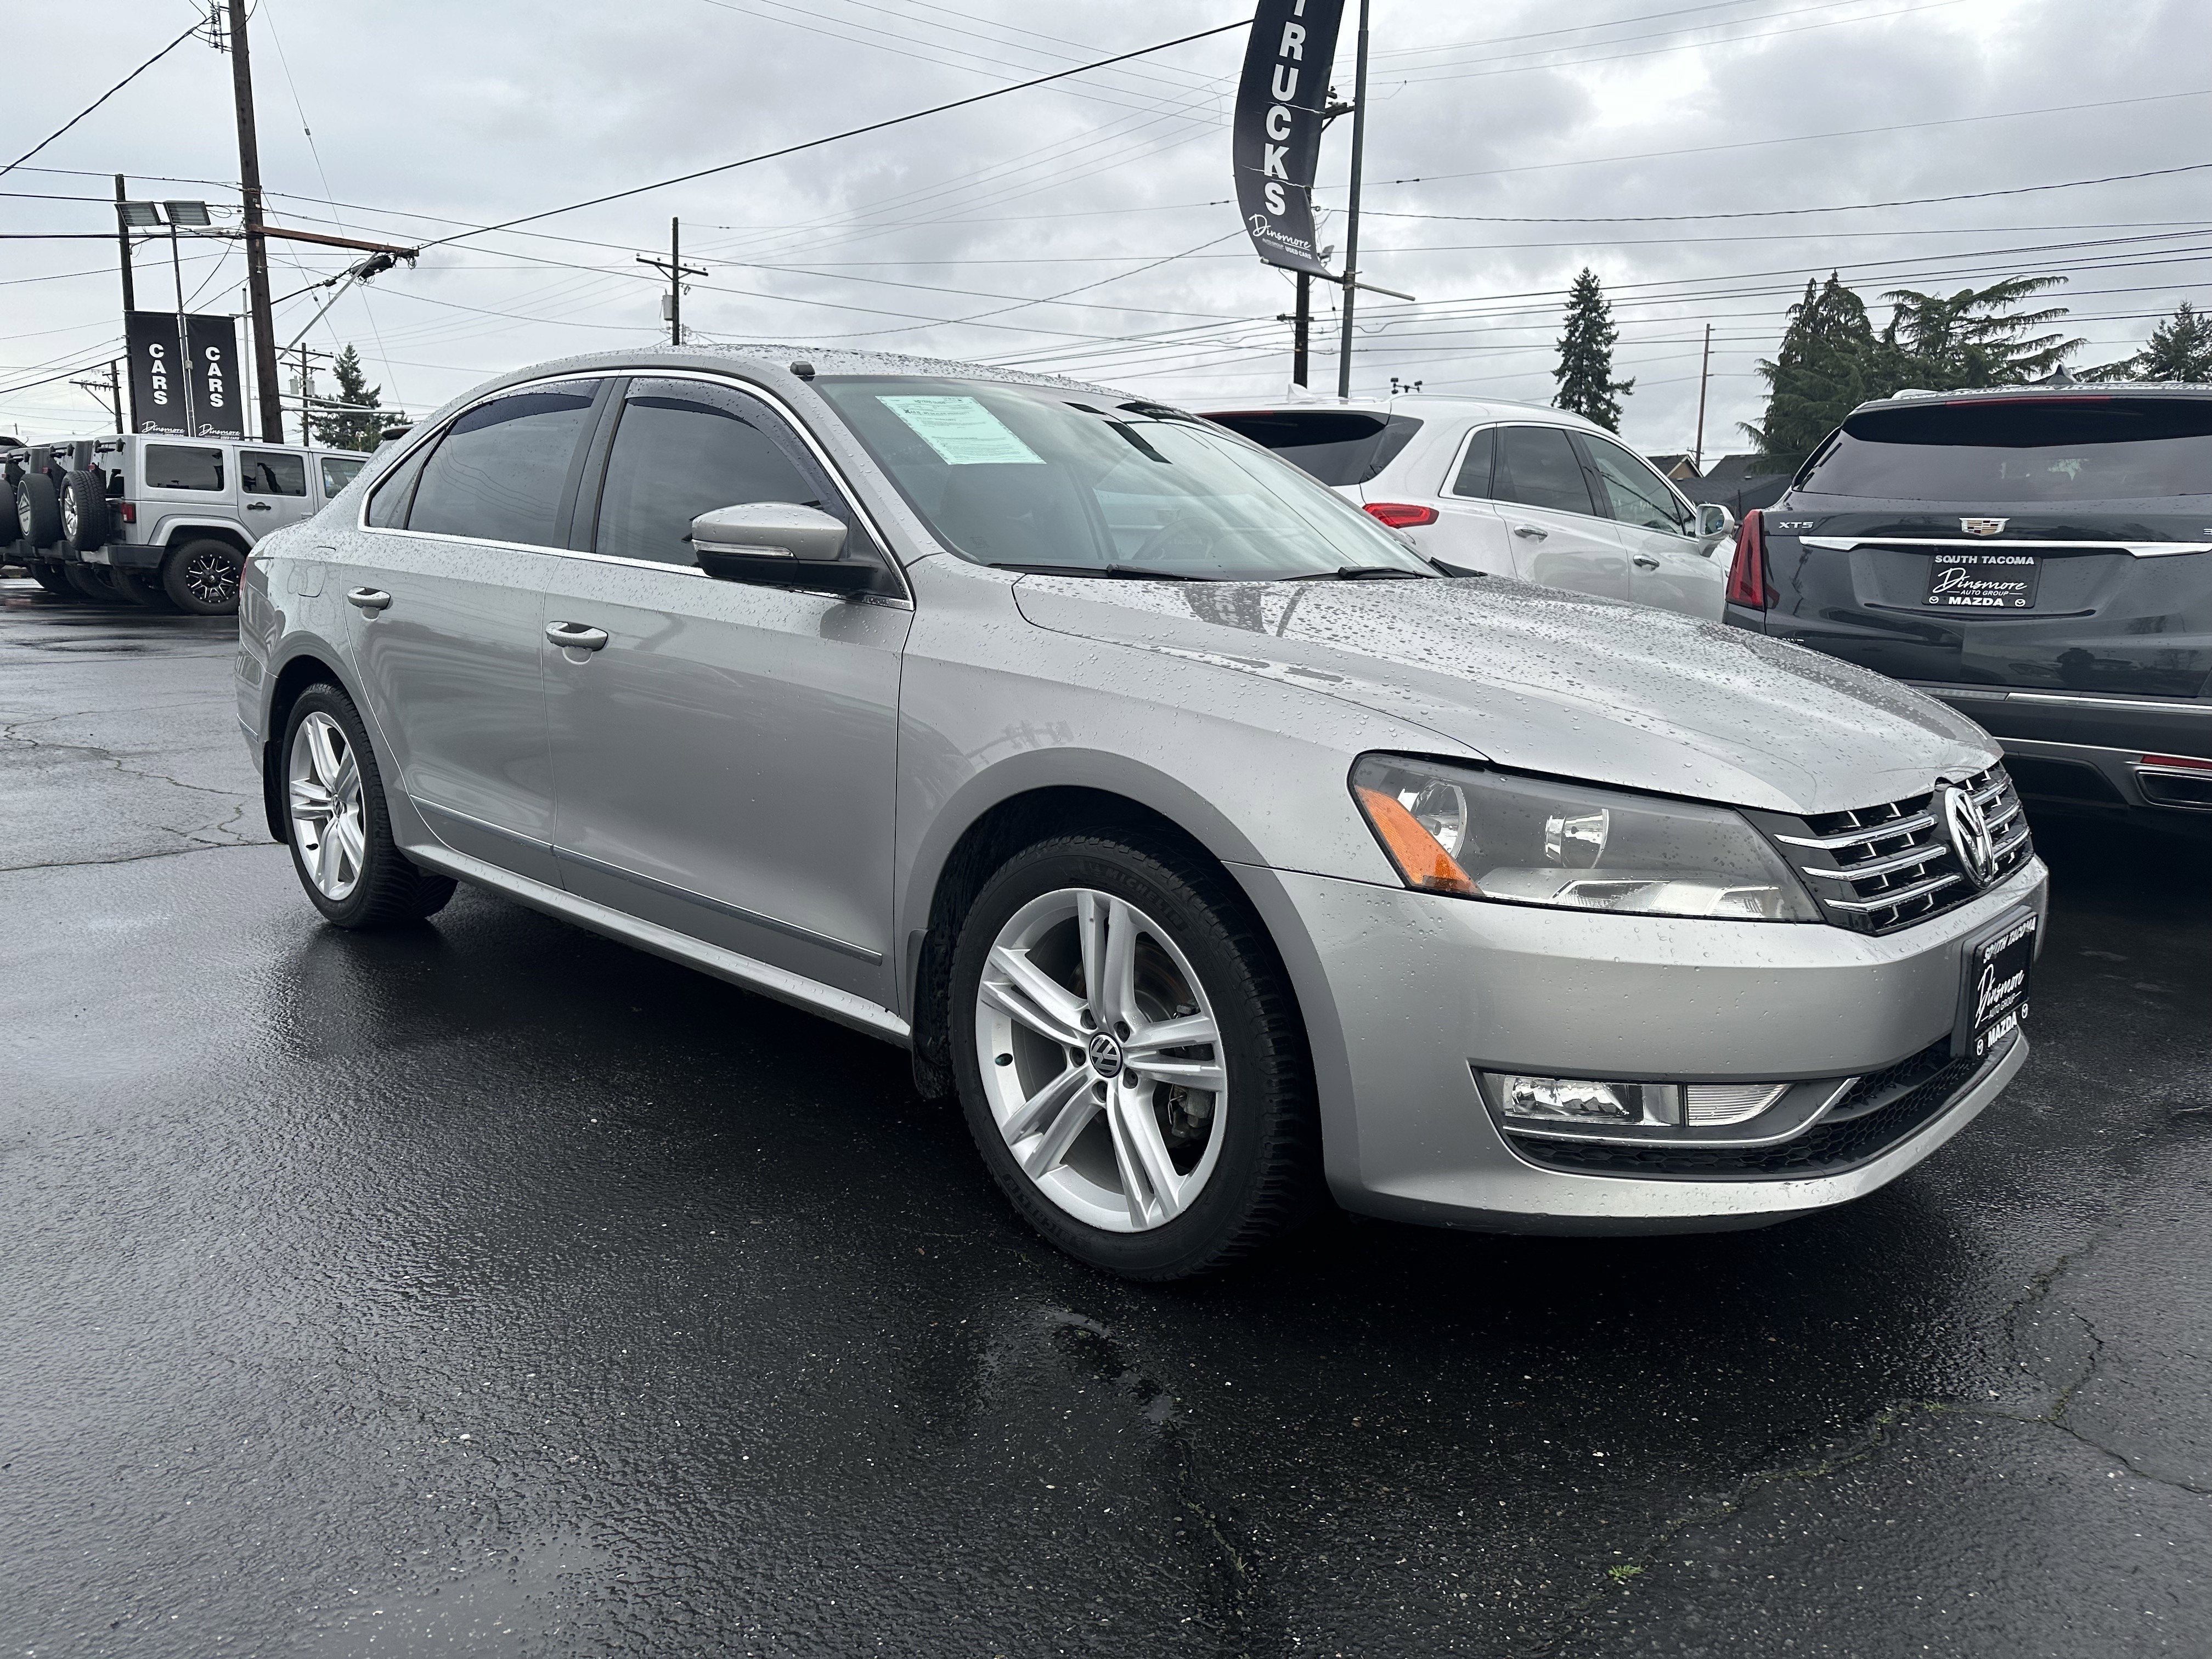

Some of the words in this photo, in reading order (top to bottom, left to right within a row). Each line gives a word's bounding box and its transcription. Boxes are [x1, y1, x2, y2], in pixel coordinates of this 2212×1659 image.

[1249, 214, 1311, 248] Dinsmore
[1299, 251, 1312, 259] CARS
[149, 344, 167, 405] CARS
[205, 347, 224, 407] CARS
[142, 421, 185, 433] Dinsmore
[199, 424, 240, 436] Dinsmore
[1935, 555, 1978, 564] SOUTH
[1982, 556, 2035, 565] TACOMA
[1932, 567, 2028, 594] Dinsmore
[1948, 597, 2004, 606] MAZDA
[1975, 964, 2024, 1029] Dinsmore
[1988, 1011, 2018, 1047] MAZDA
